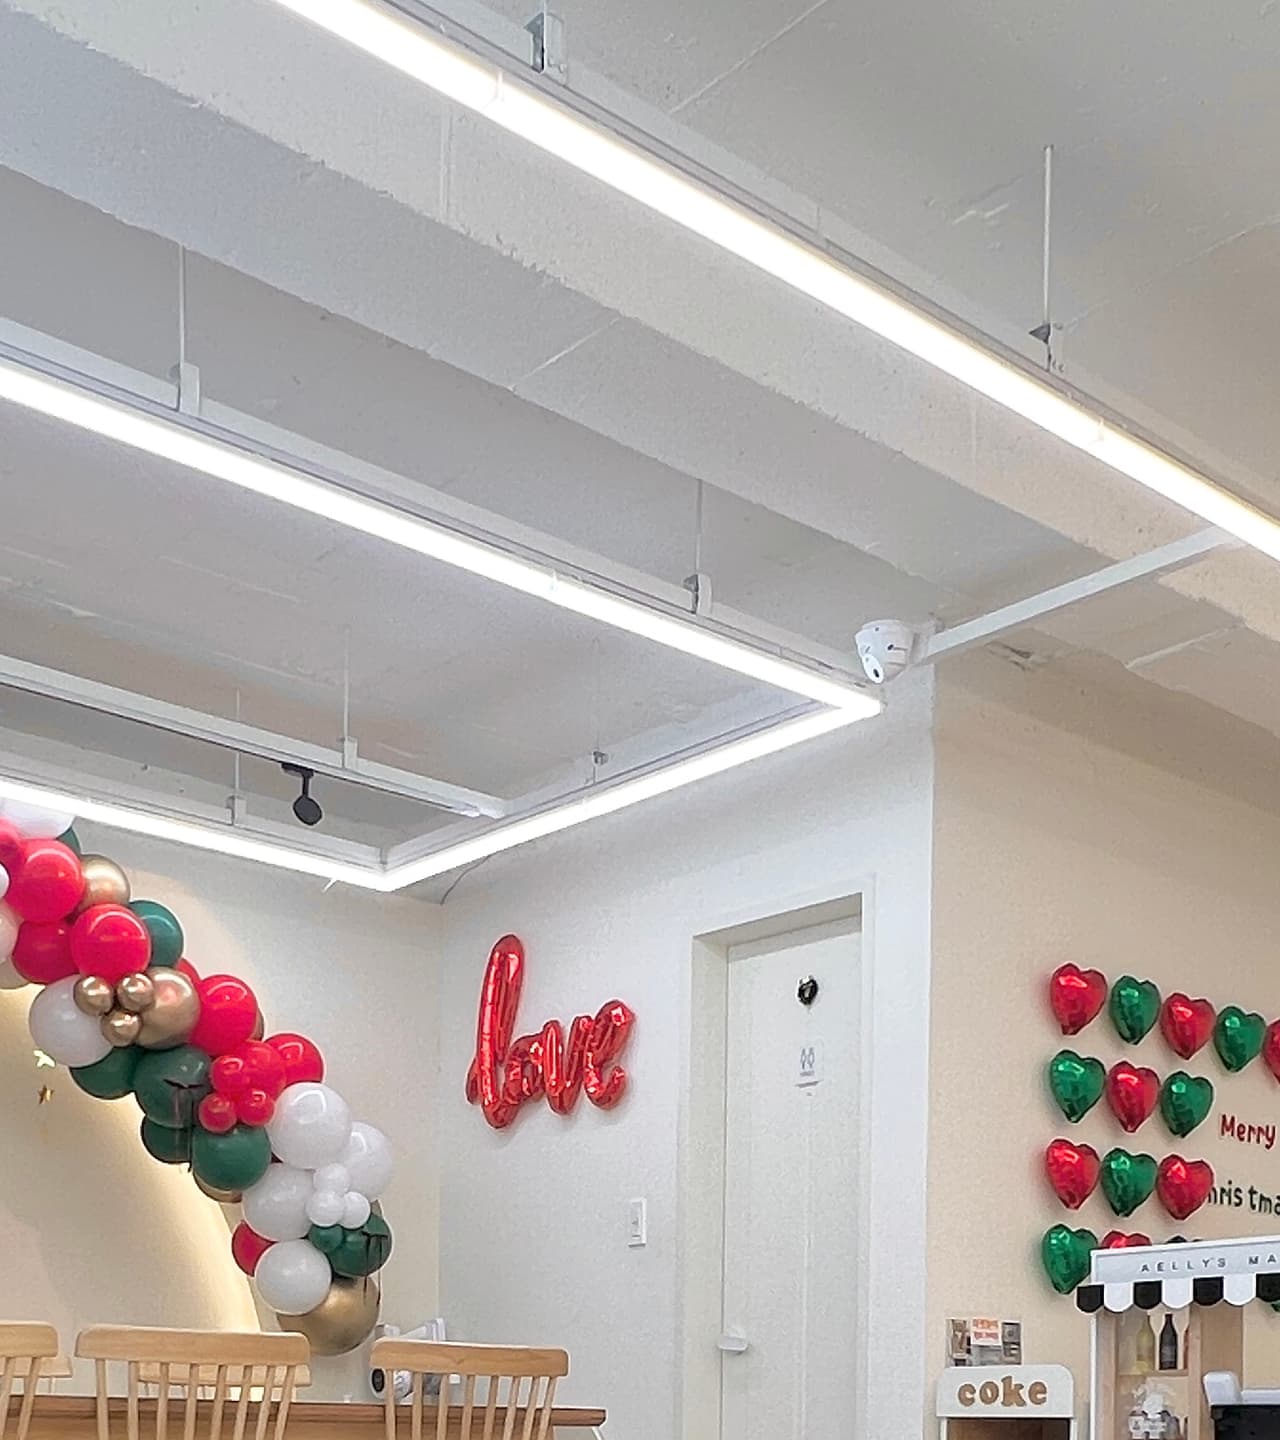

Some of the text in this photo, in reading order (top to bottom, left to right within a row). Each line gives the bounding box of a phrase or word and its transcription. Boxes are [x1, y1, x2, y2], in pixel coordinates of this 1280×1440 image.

[466, 934, 635, 1129] love
[1220, 1114, 1277, 1150] Merry
[957, 1375, 1048, 1407] coke
